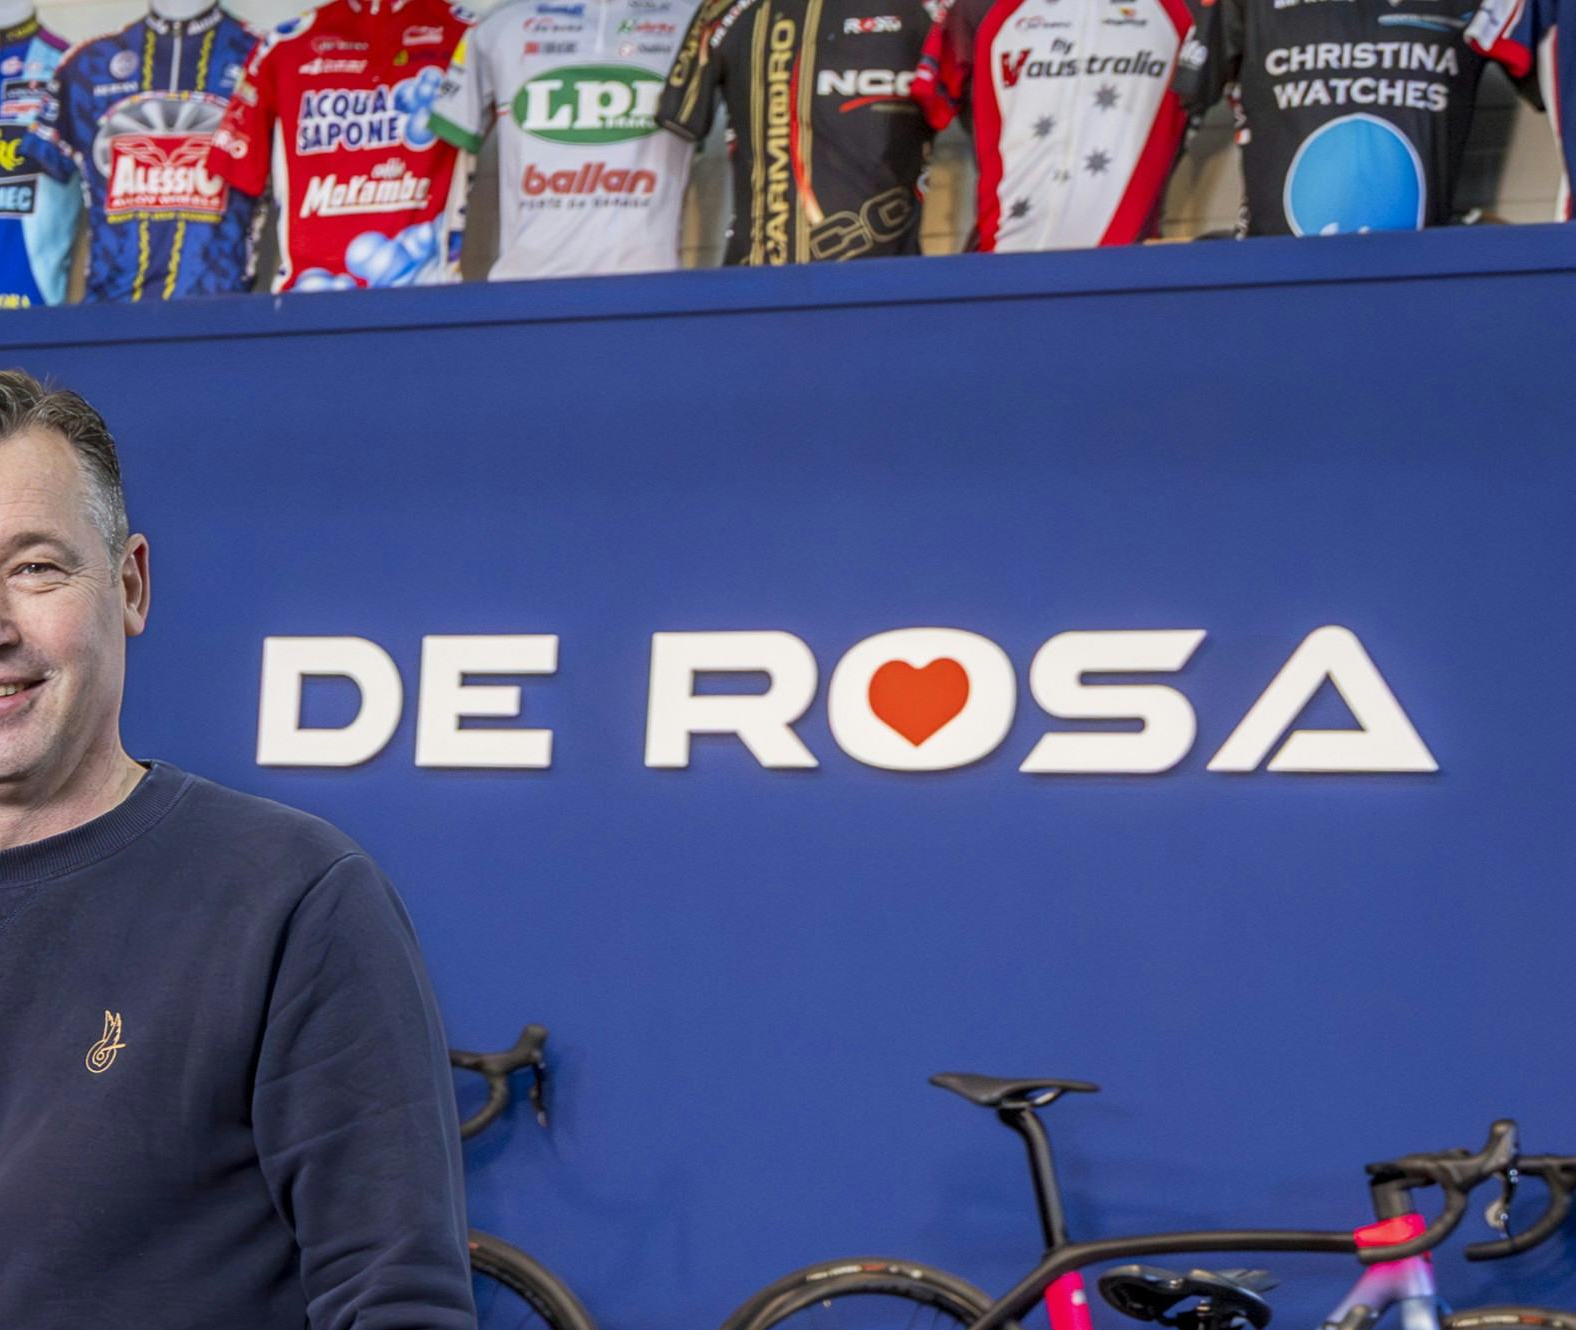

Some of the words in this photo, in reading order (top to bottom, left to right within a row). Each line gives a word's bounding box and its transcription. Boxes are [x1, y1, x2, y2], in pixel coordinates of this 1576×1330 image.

[1265, 41, 1459, 76] CHRISTINA
[303, 87, 388, 119] ACQUA
[1273, 78, 1449, 112] WATCHES
[301, 117, 398, 150] SAPONE
[522, 162, 656, 196] ballan
[256, 634, 559, 768] DE
[644, 624, 1441, 773] ROSA
